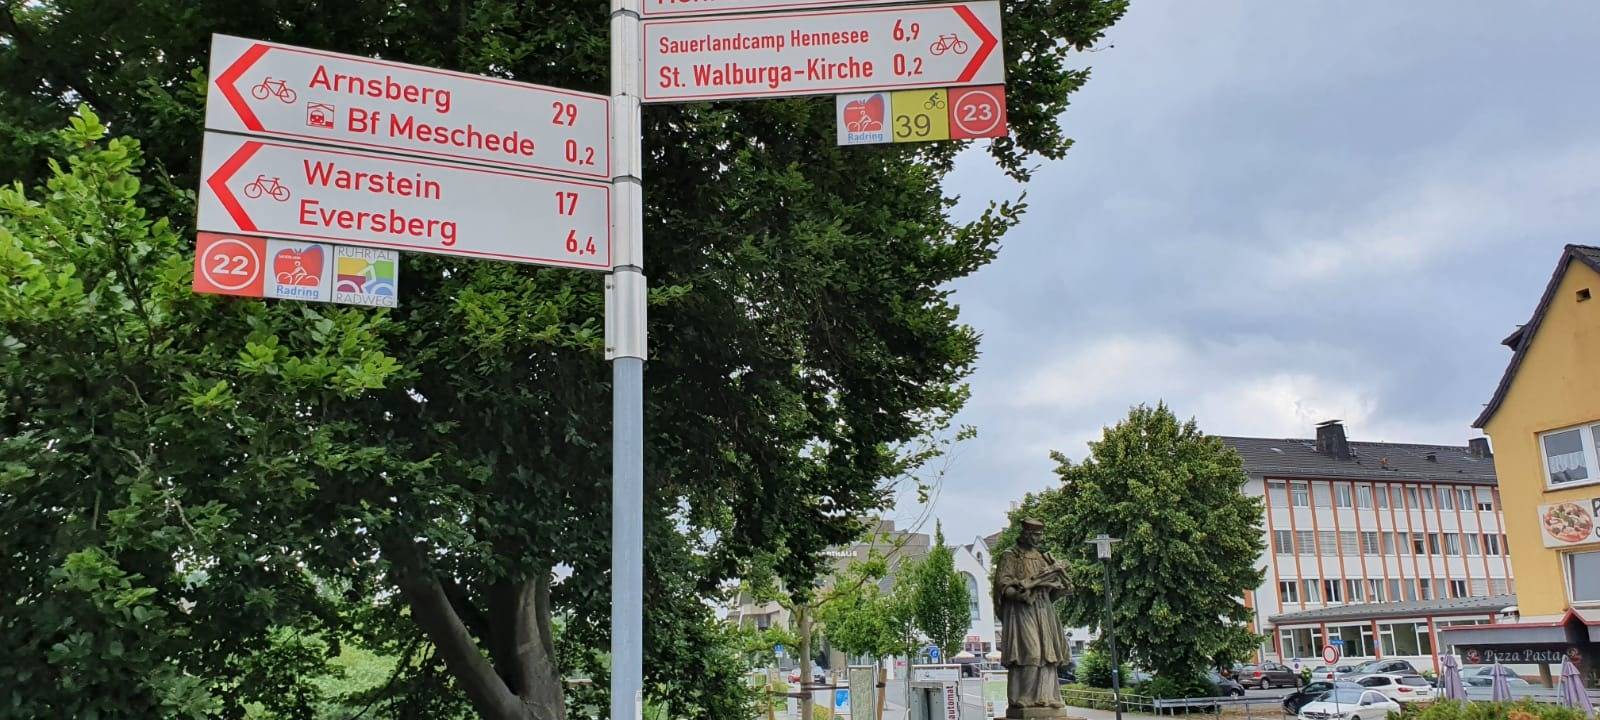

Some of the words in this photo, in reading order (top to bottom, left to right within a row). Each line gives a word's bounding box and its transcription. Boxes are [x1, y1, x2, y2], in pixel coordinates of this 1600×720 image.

[659, 26, 785, 54] Sauerlandcamp
[790, 28, 870, 47] Hennesee
[892, 19, 920, 42] 6,9
[659, 65, 685, 88] St.
[693, 56, 874, 89] Walburga-Kirche
[893, 53, 923, 76] 0,2
[308, 64, 451, 113] Arnsberg
[552, 101, 578, 127] 29
[962, 103, 992, 122] 23
[348, 107, 380, 133] Bf
[389, 112, 535, 157] Meschede
[564, 139, 595, 166] 0,2
[847, 132, 883, 143] Radring
[895, 113, 931, 138] 39
[303, 159, 441, 200] Warstein
[555, 191, 578, 216] 17
[299, 199, 457, 246] Eversberg
[565, 229, 596, 256] 6,4
[212, 253, 249, 276] 22
[337, 246, 394, 262] RUHRTAL
[276, 285, 320, 299] Radring
[336, 293, 393, 307] RADWEG
[1484, 649, 1520, 662] Pizza
[1523, 649, 1561, 662] Pasta
